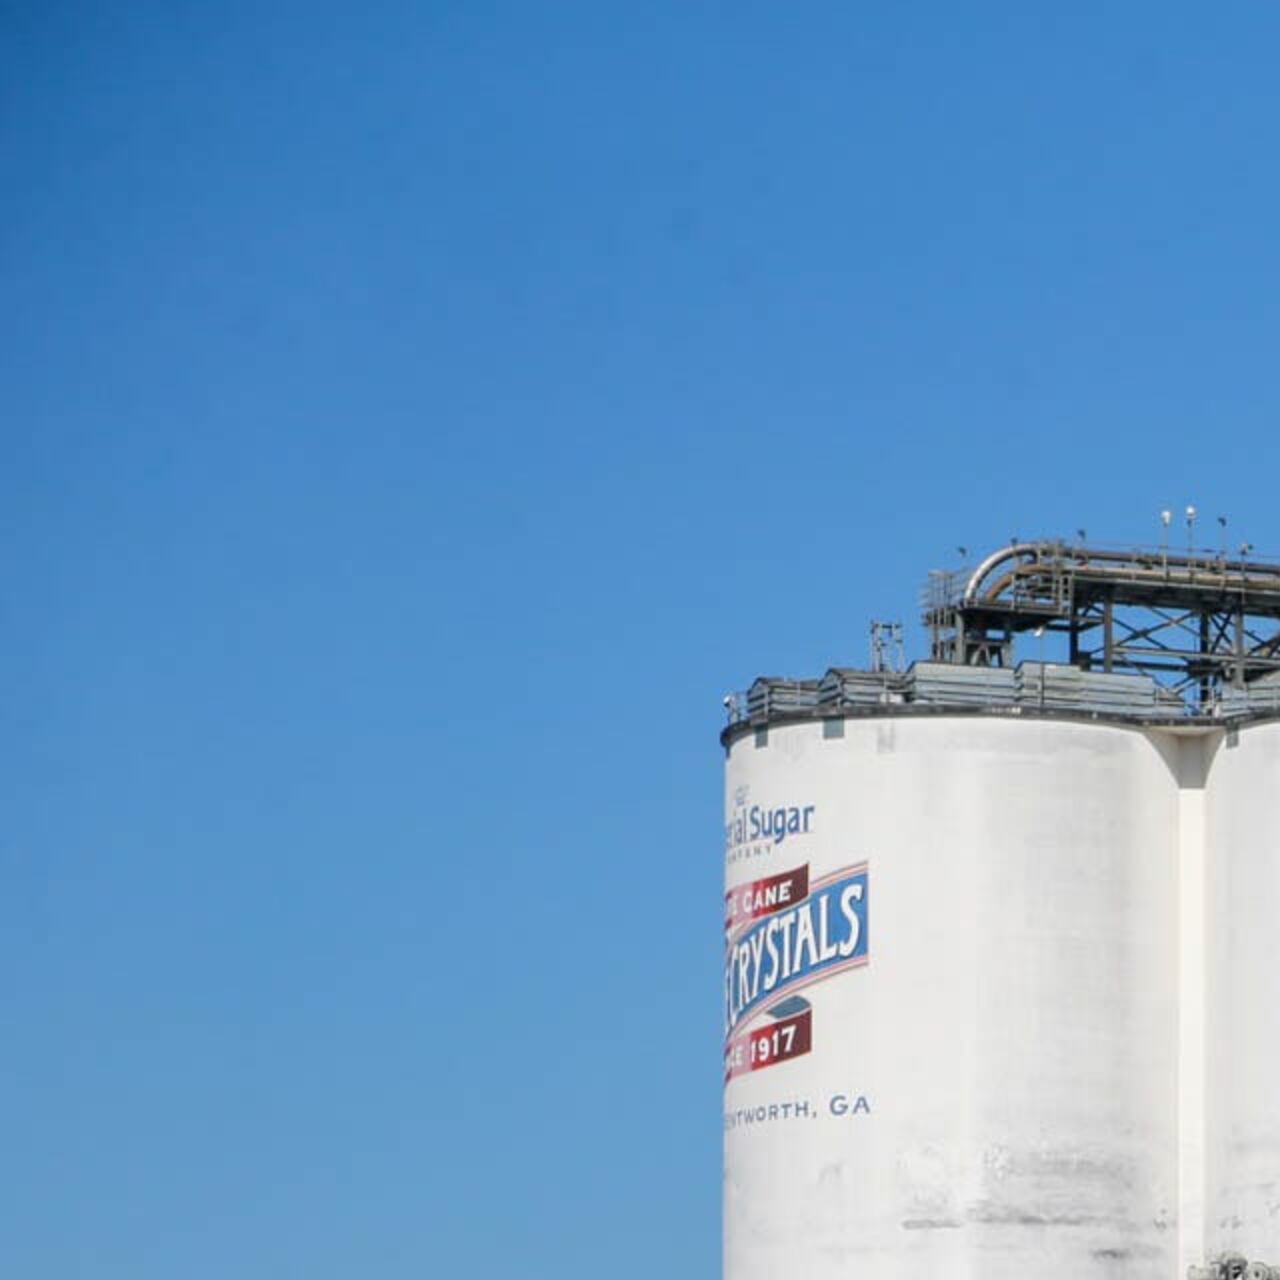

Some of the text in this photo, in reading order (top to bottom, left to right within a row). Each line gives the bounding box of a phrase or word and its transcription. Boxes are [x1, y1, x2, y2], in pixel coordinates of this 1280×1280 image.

[750, 804, 815, 845] Sugar
[743, 879, 793, 912] CANE
[729, 882, 864, 1027] CRYSTALS
[751, 1024, 797, 1063] 1917
[829, 1095, 871, 1117] GA
